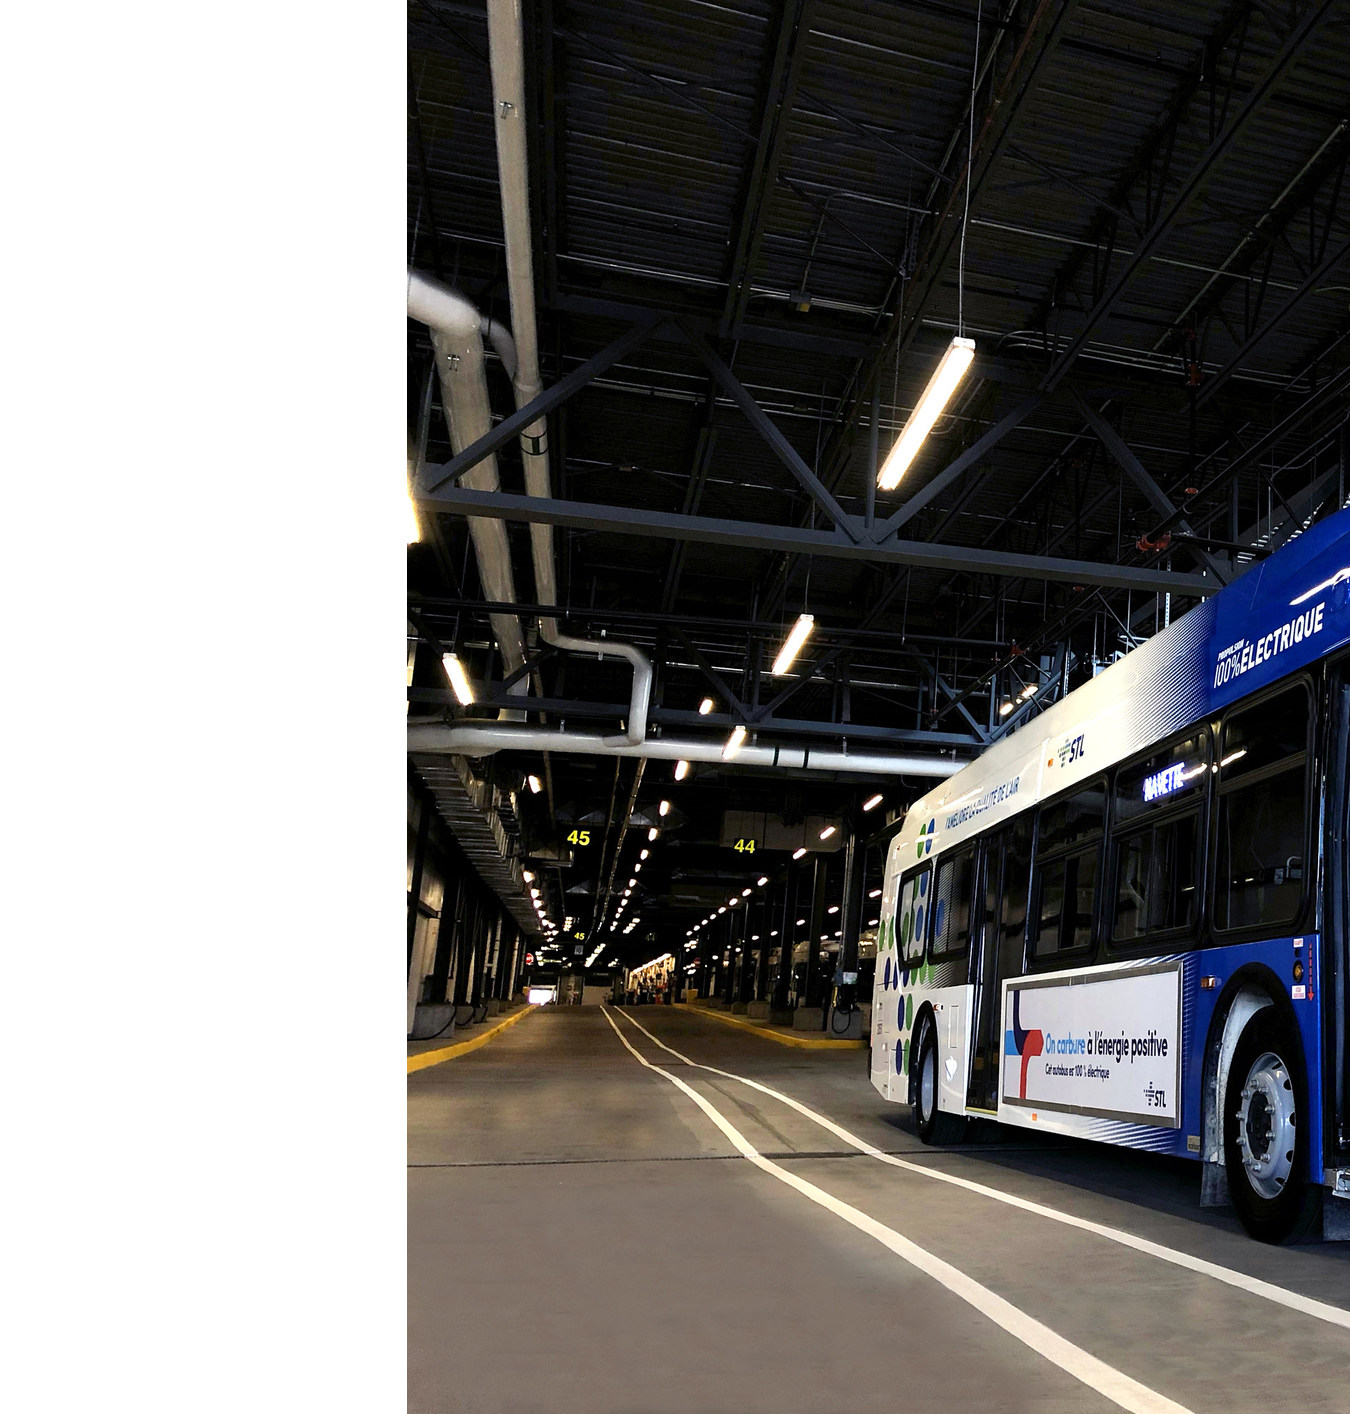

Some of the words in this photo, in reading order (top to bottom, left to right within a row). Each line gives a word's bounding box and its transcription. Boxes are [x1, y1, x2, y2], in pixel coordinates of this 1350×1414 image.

[1217, 638, 1245, 661] PROPULSION
[1069, 733, 1085, 763] STL
[1143, 761, 1185, 802] NAVETTE
[997, 784, 1006, 803] DE
[567, 829, 591, 846] 45
[734, 838, 756, 854] 44
[574, 932, 585, 940] 45
[1045, 1033, 1056, 1054] On
[1057, 1032, 1086, 1055] carbure
[1087, 1031, 1093, 1055] à
[1094, 1030, 1129, 1063] l'énergie
[1131, 1030, 1168, 1064] positive
[1053, 1064, 1068, 1076] autobus
[1087, 1064, 1110, 1082] électrique
[1154, 1090, 1167, 1108] STL
